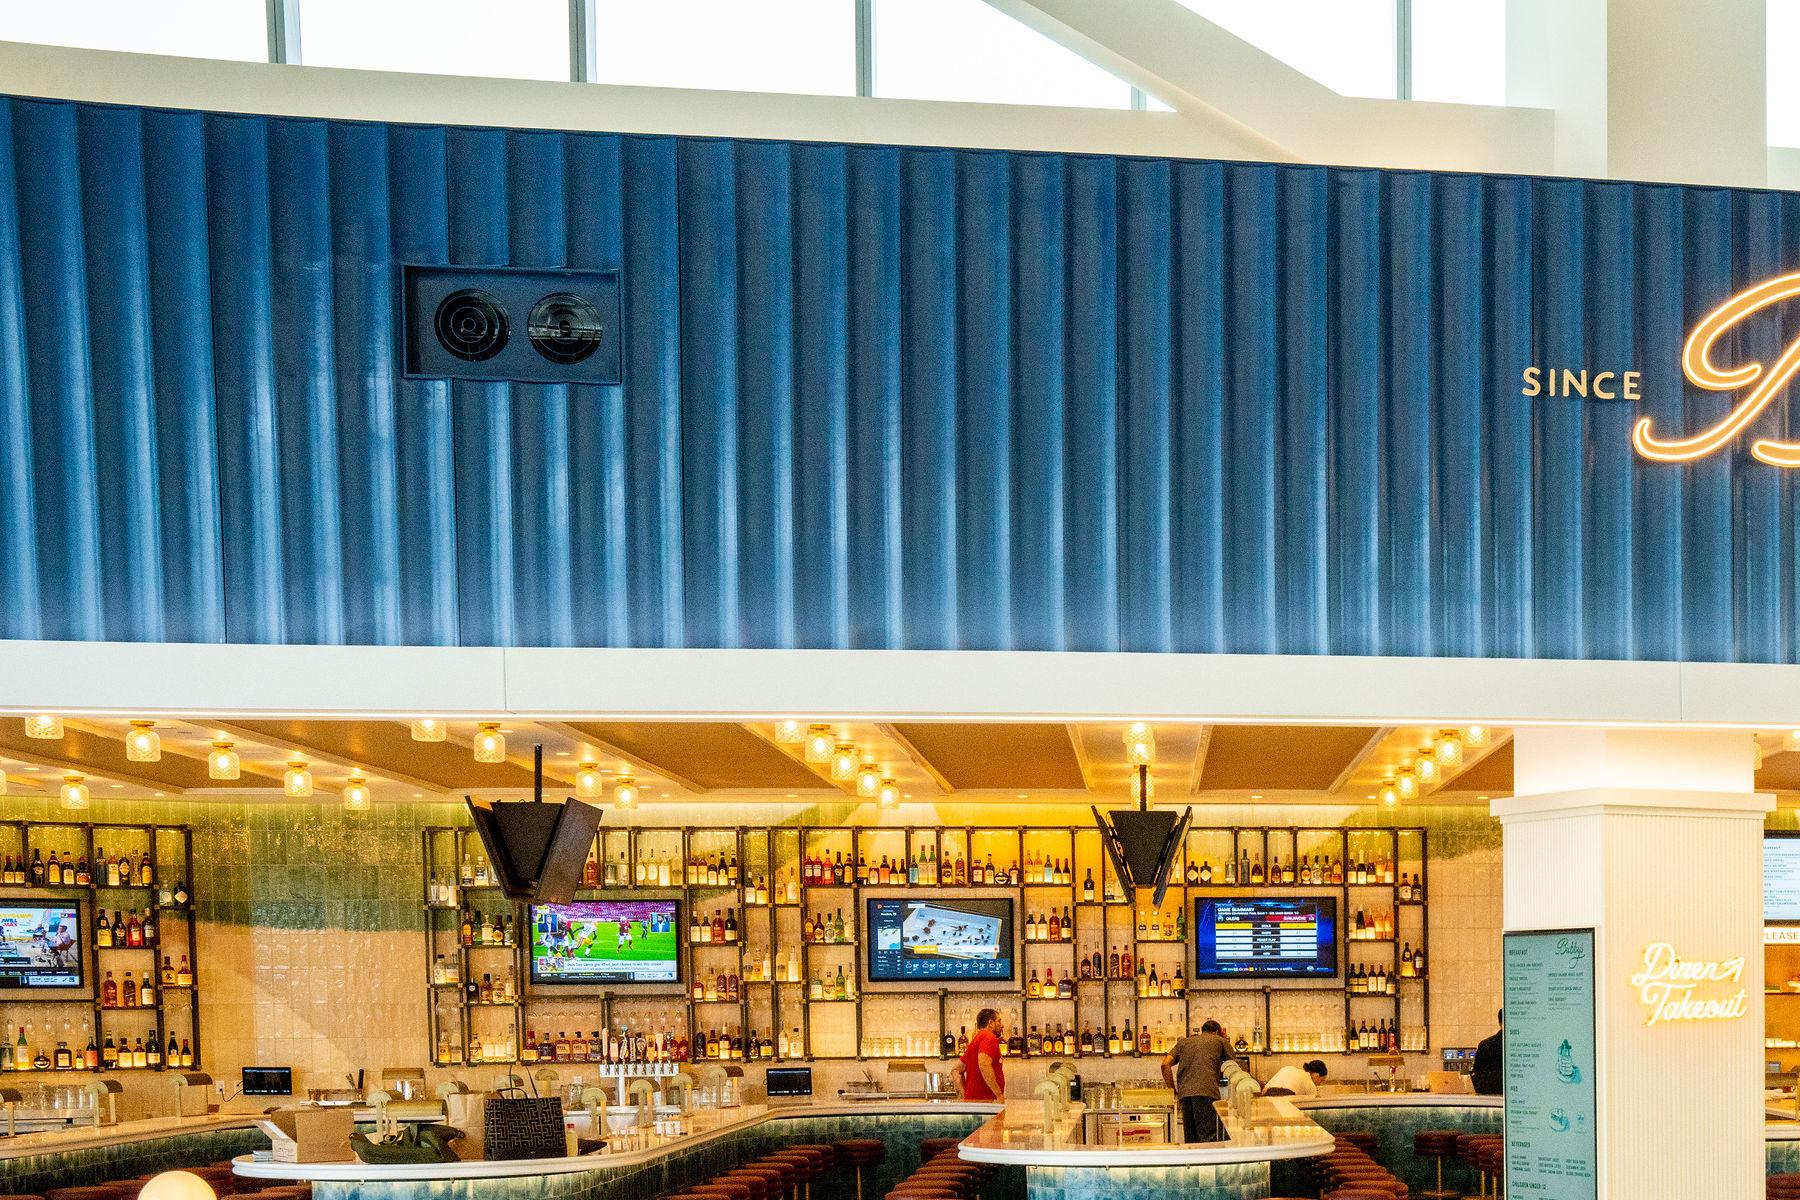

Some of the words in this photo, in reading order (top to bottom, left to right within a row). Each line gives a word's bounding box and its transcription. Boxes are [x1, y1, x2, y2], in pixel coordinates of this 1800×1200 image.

[1522, 367, 1642, 400] SINCE
[1764, 931, 1800, 940] LEASE
[1641, 981, 1748, 1026] Takeout
